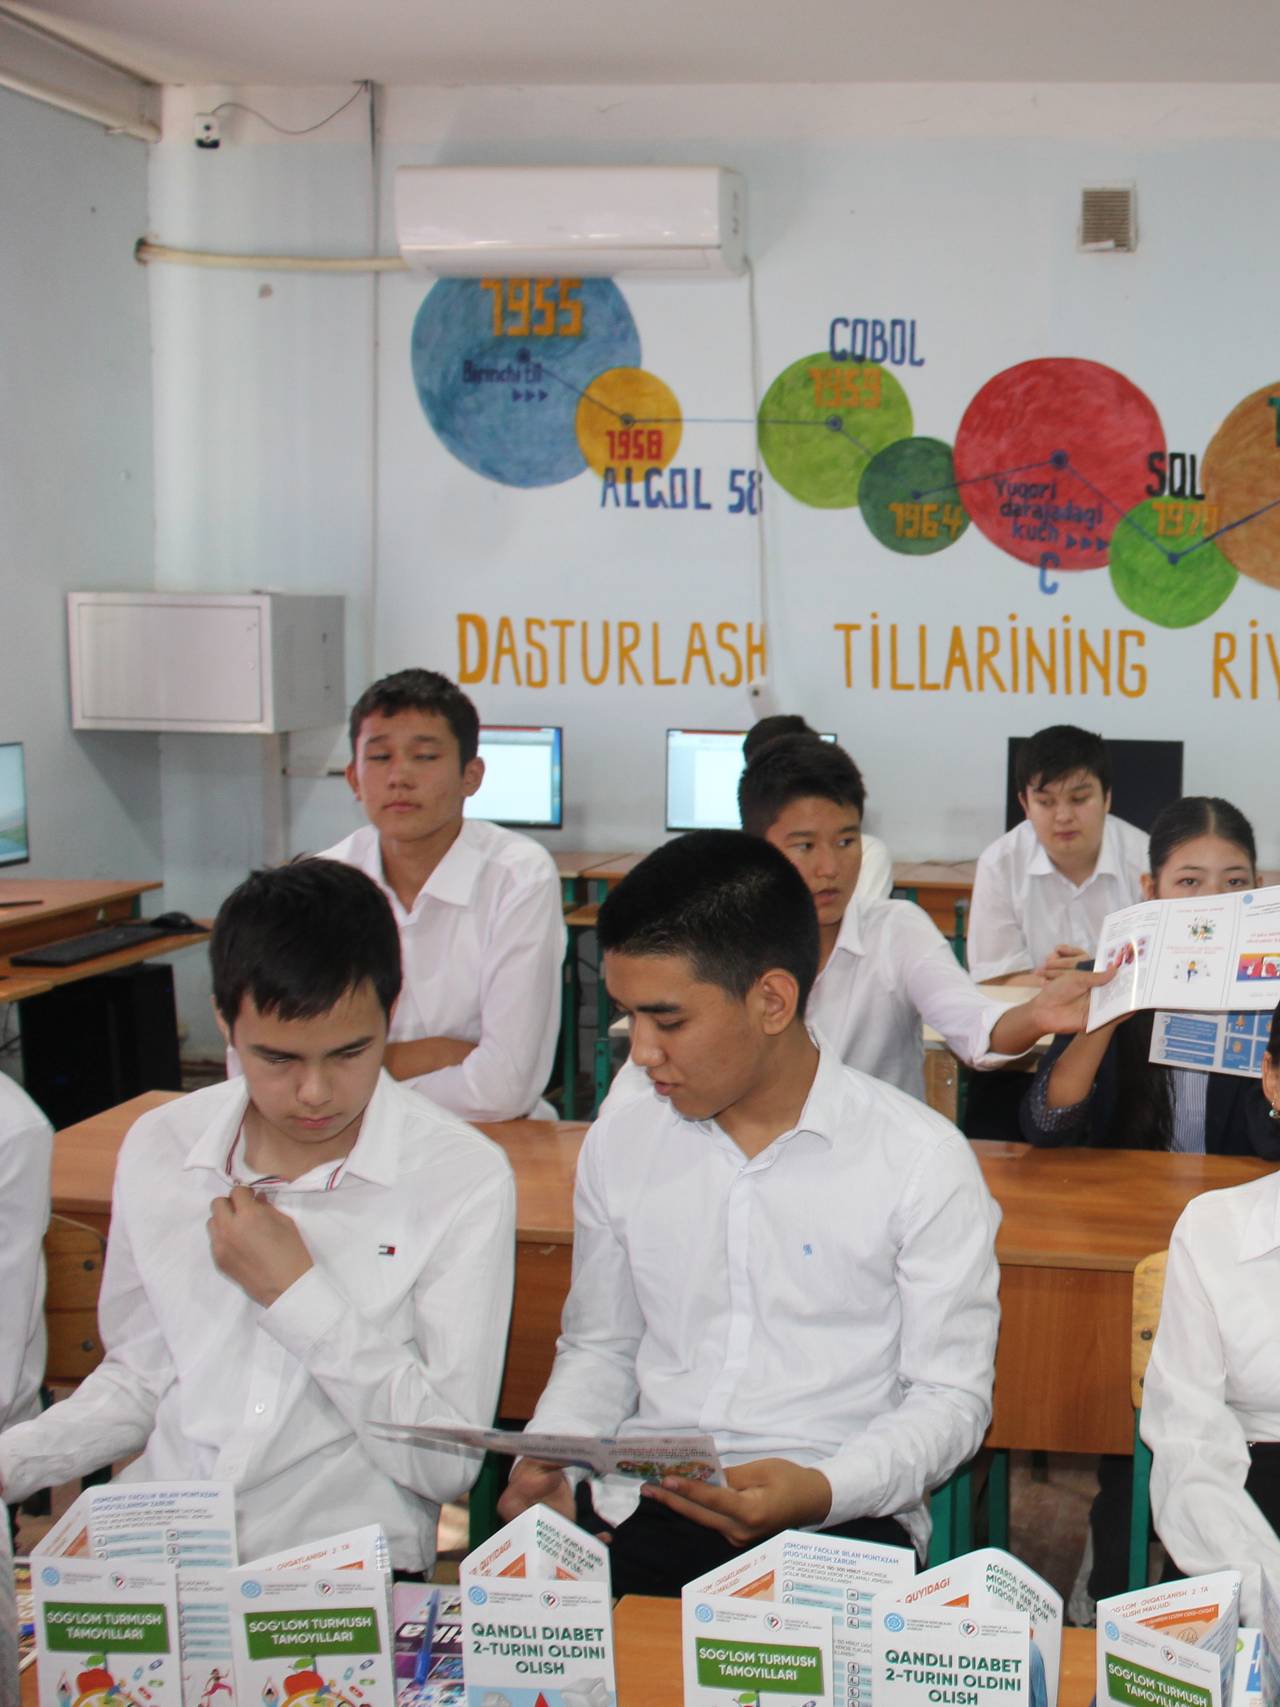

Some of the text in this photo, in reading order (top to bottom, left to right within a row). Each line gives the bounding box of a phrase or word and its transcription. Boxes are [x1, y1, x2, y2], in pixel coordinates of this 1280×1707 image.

[480, 277, 584, 337] 1955
[829, 317, 925, 367] COBOL
[606, 430, 663, 461] 1958
[1145, 452, 1205, 500] SQL
[600, 466, 712, 511] ALGOL
[888, 502, 963, 541] 1964
[1039, 552, 1060, 595] C
[456, 612, 766, 688] DASTURLASH
[105, 1612, 161, 1626] TURMUSH
[249, 1616, 372, 1633] SOG'LOM TURMUSH
[66, 1627, 144, 1641] TAMOYILLARI
[271, 1631, 353, 1645] TAMOYILLARI
[471, 1622, 537, 1640] QANDLI
[542, 1626, 604, 1642] DIABET
[473, 1641, 605, 1659] 2-TURINI OLDINI
[699, 1647, 816, 1668] SOG'LOM TURMUSH
[885, 1649, 1022, 1673] QANDLI DIABET
[515, 1660, 565, 1675] OLISH
[718, 1664, 797, 1681] TAMOYILLARI
[885, 1667, 1021, 1691] 2-TURINI OLDINI
[928, 1689, 978, 1705] OLISH
[1108, 1663, 1155, 1690] SOG'LOM
[1156, 1680, 1207, 1707] TURMUSH
